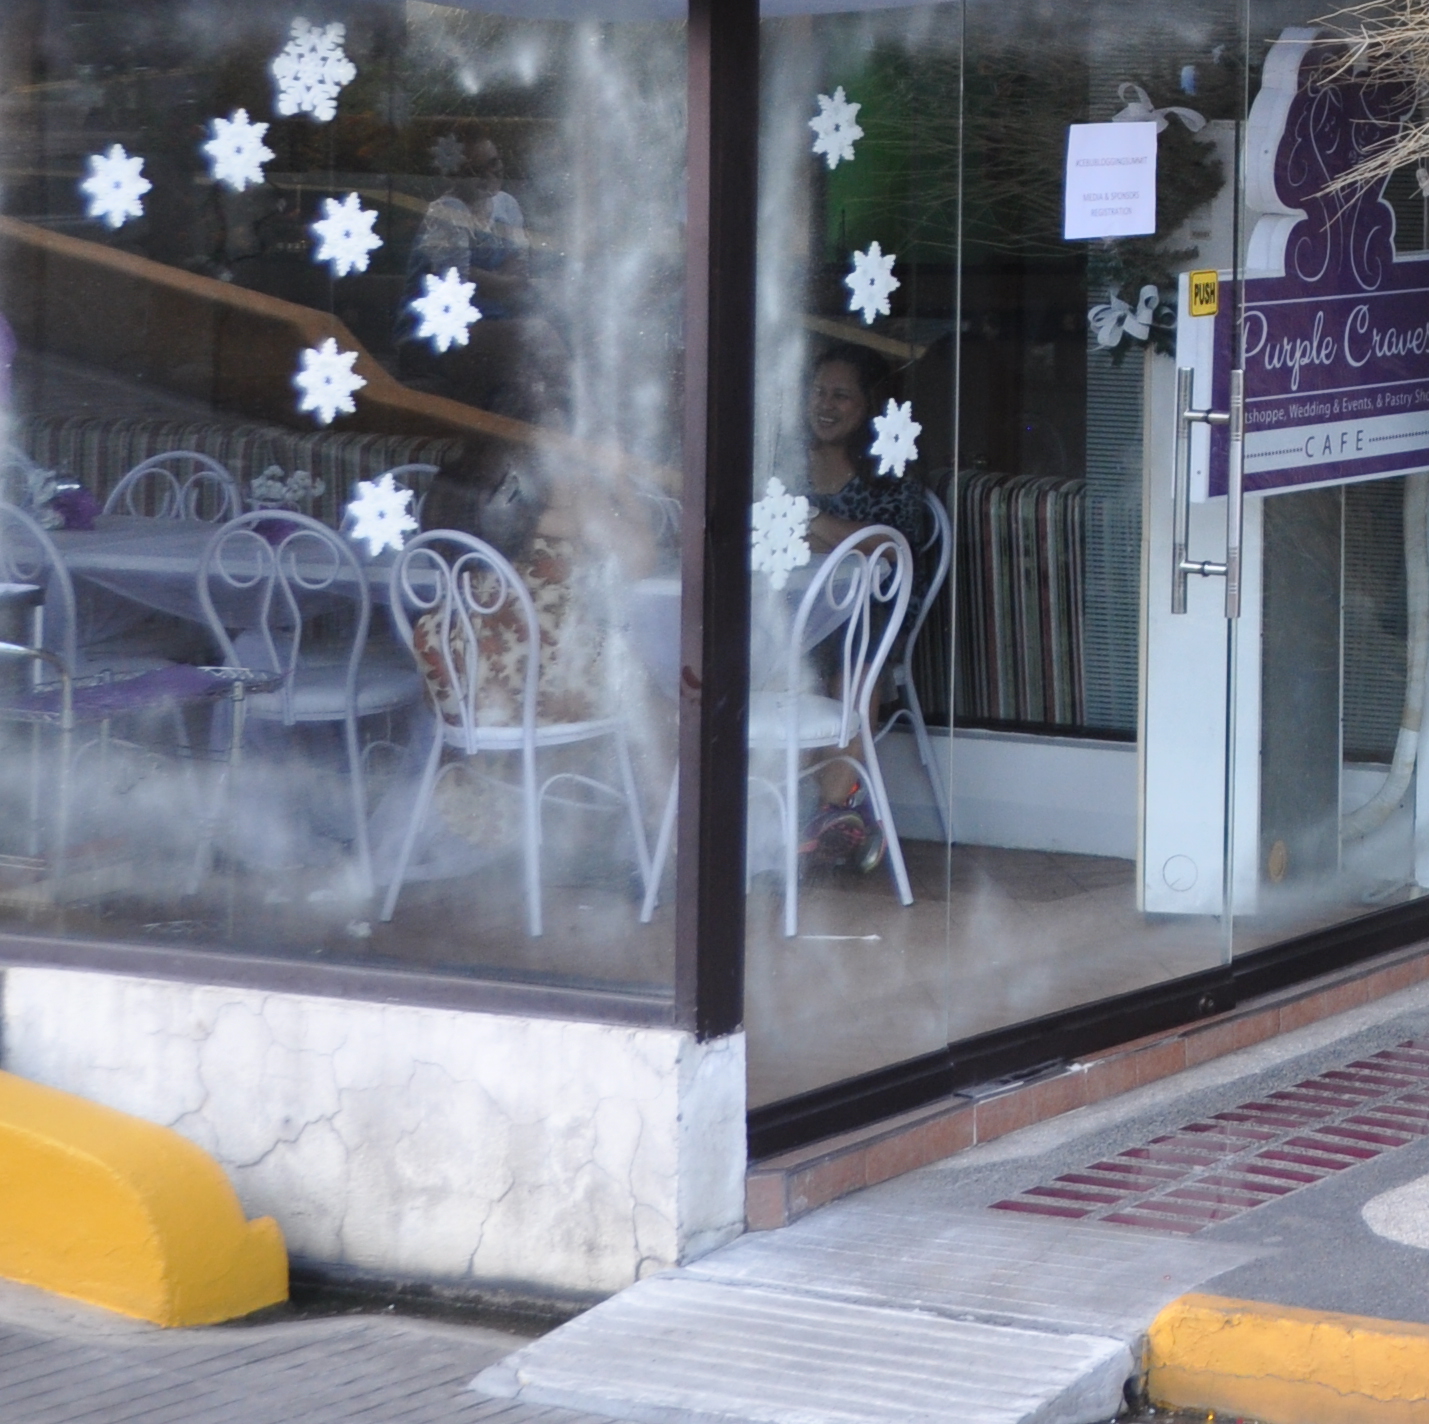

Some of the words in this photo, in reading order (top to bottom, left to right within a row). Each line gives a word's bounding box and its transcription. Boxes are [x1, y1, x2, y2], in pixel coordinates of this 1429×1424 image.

[1083, 193, 1103, 202] MEDIA
[1104, 192, 1109, 201] &
[1110, 191, 1139, 201] SPONSORS
[1090, 207, 1132, 217] REGISTRATION
[1194, 281, 1216, 306] PUSH
[1237, 310, 1337, 391] Purple
[1244, 409, 1287, 425] tshoppe,
[1289, 402, 1331, 419] Wedding
[1332, 400, 1340, 414] &
[1342, 397, 1374, 412] Events,
[1376, 394, 1383, 407] &
[1385, 391, 1412, 406] Pastry
[1304, 429, 1364, 458] CAFE
